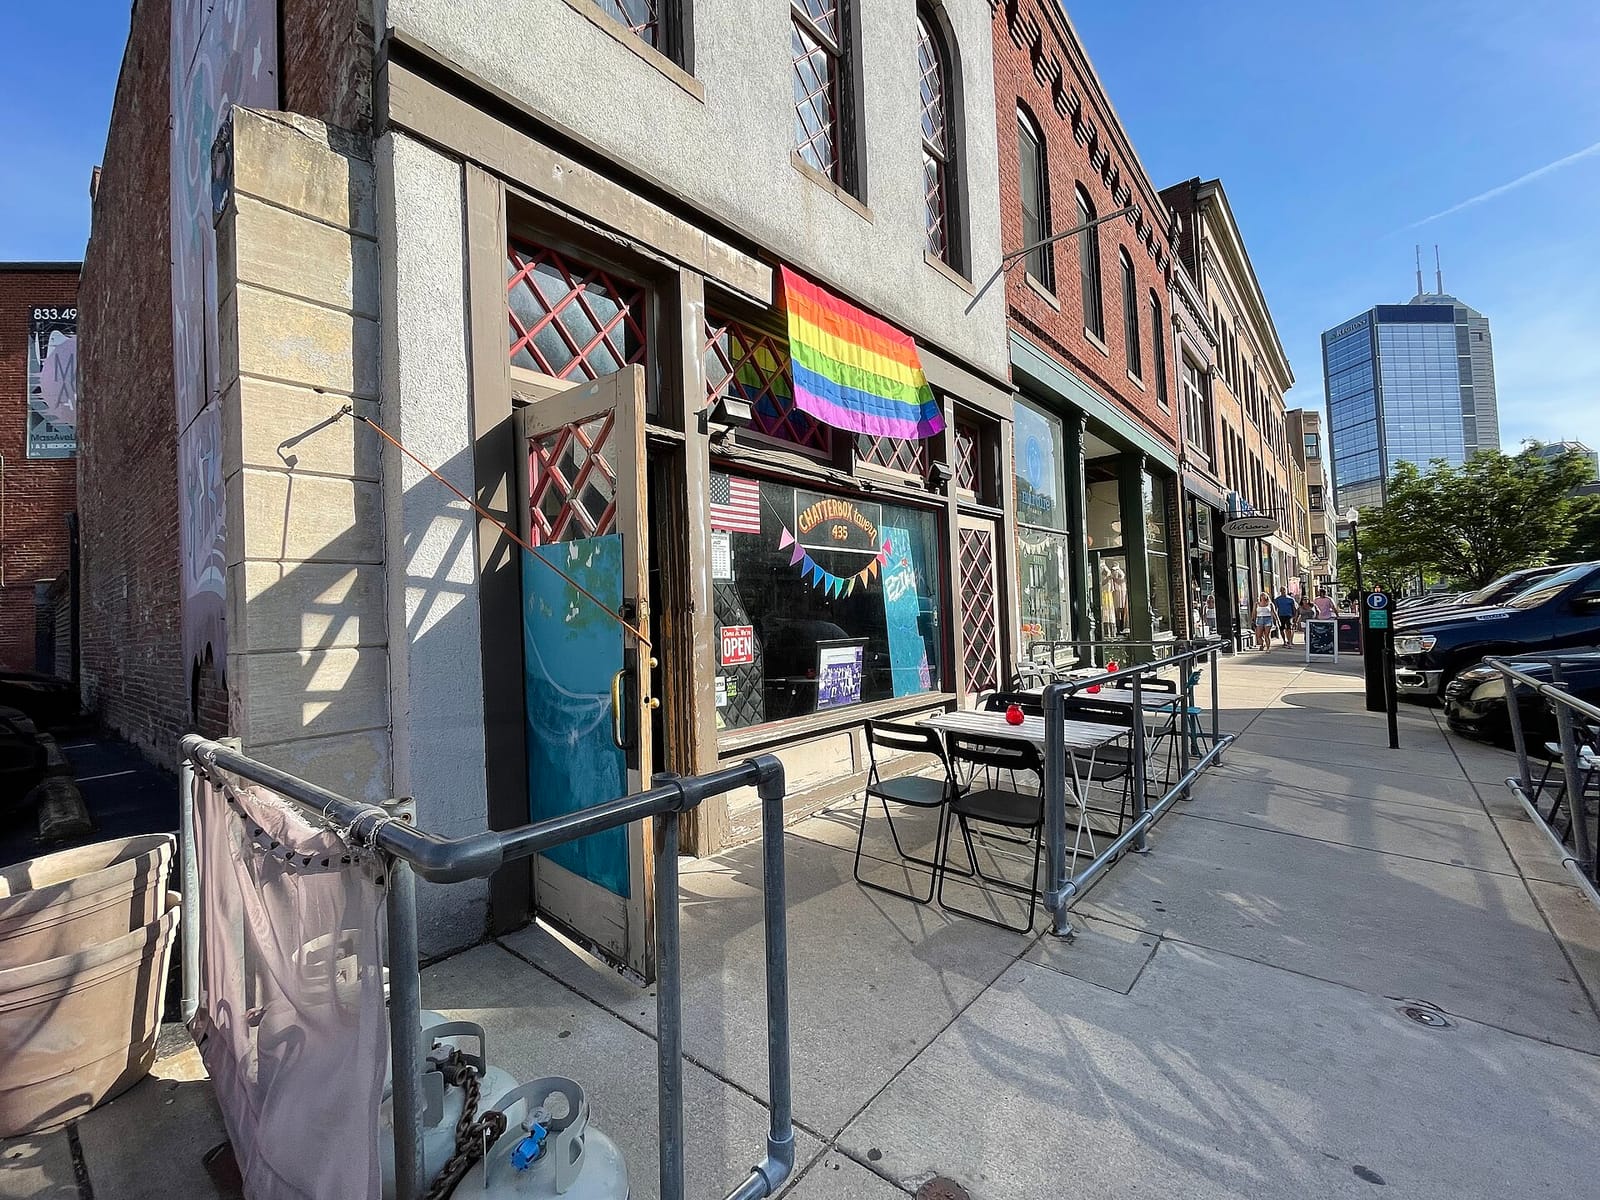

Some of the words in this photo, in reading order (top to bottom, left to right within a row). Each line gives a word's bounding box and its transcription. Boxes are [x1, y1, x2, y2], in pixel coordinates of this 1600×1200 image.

[33, 308, 78, 320] 833.49
[798, 499, 853, 534] CHATTERBOX
[853, 507, 877, 547] tavern
[831, 524, 849, 541] 435
[723, 636, 752, 658] OPEN
